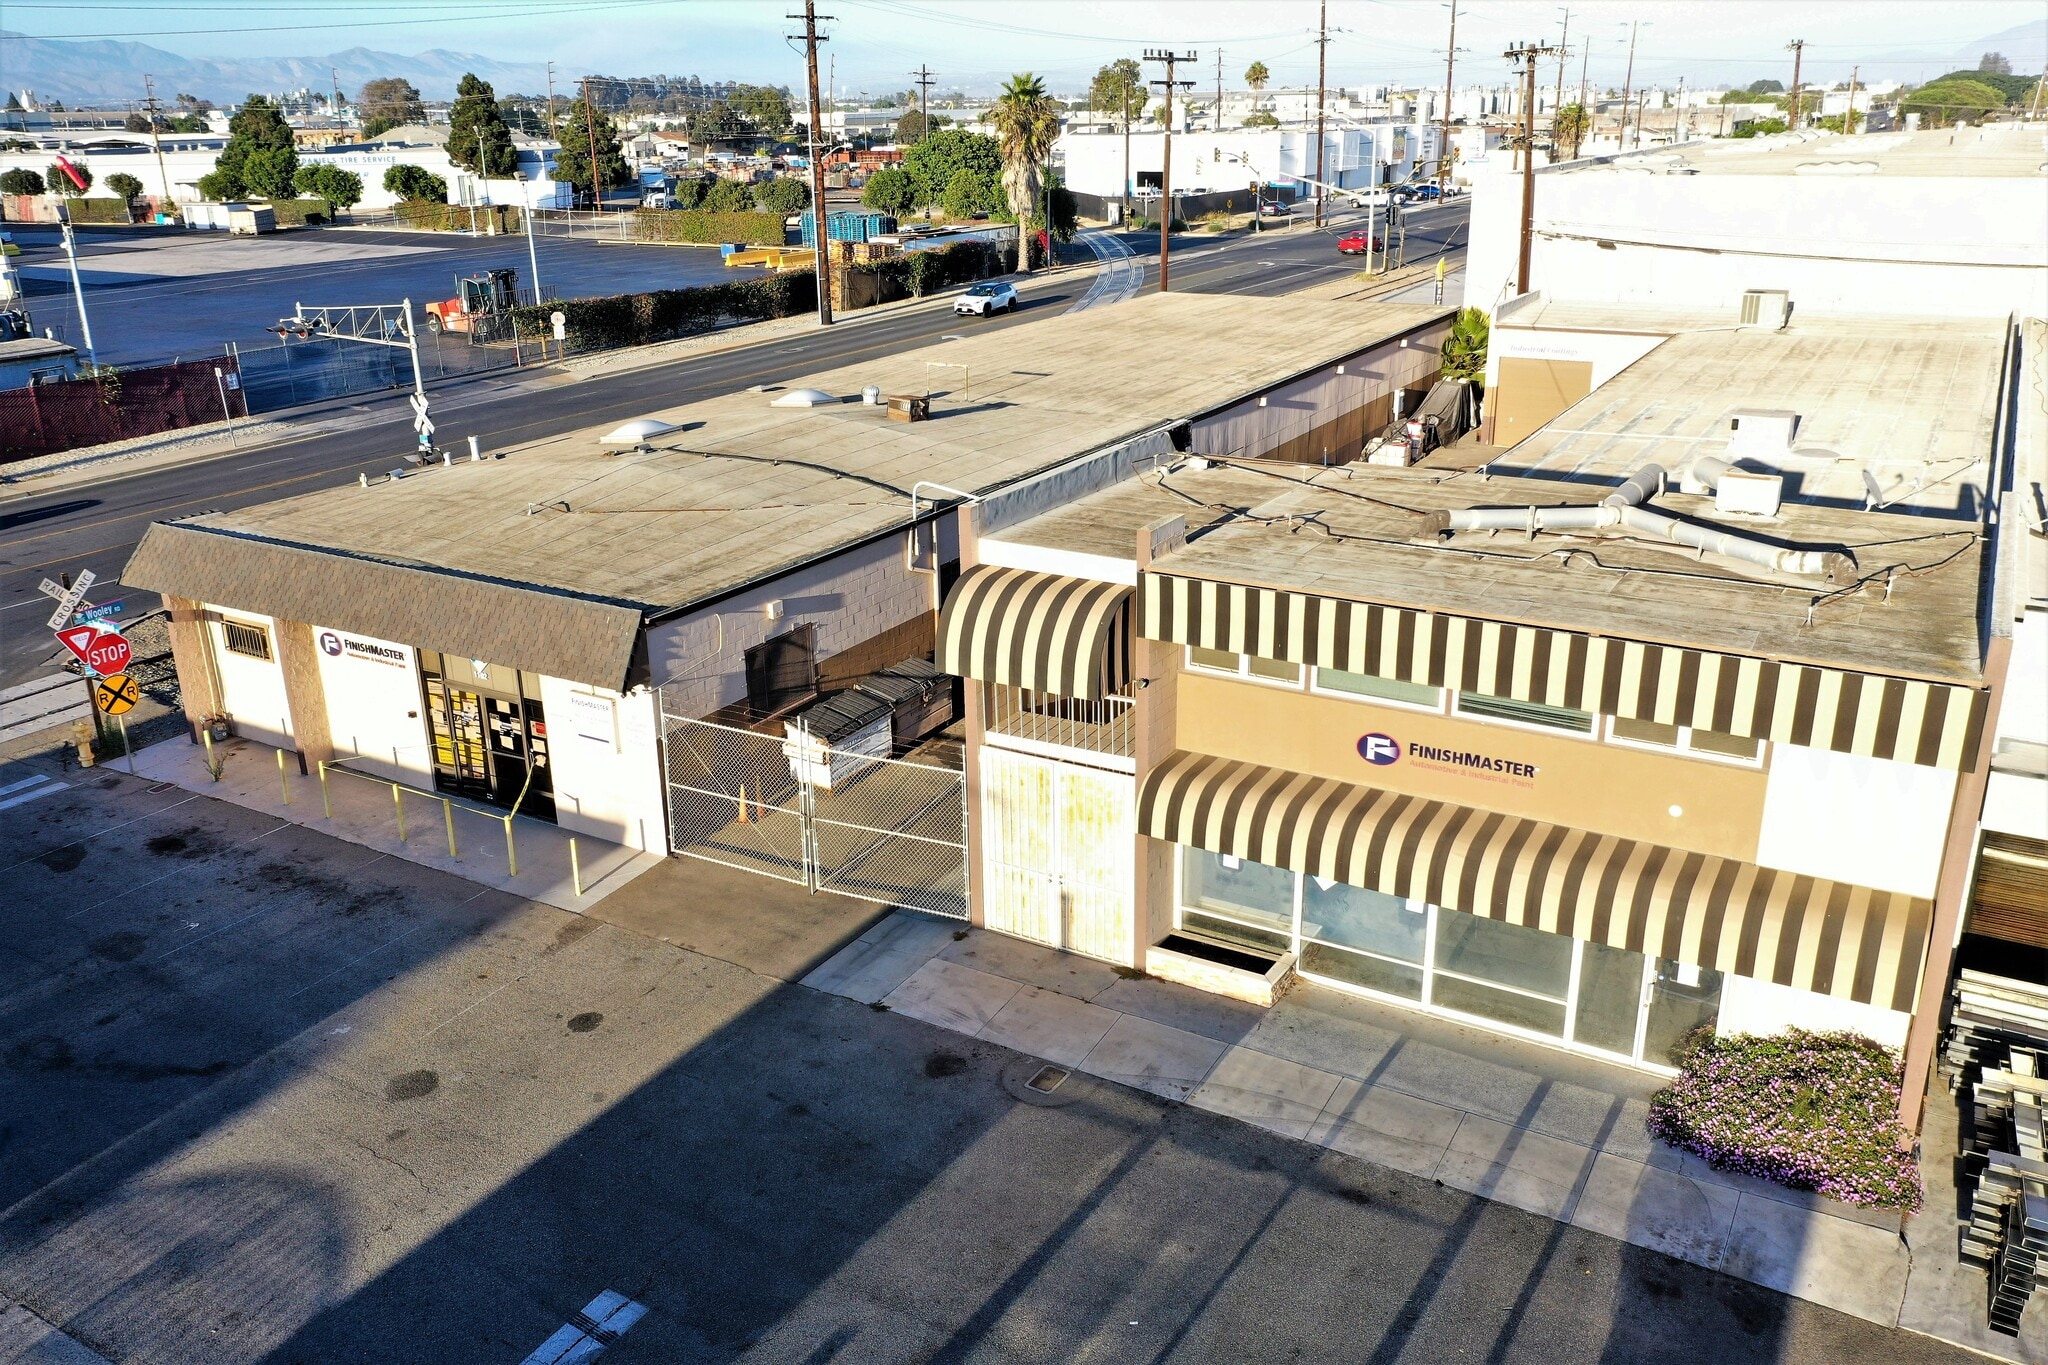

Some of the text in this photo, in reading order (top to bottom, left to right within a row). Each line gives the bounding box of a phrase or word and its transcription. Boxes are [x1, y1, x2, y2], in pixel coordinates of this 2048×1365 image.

[362, 155, 397, 163] SERVICE
[41, 580, 65, 600] RAIL
[53, 573, 92, 627] CROSSING
[85, 602, 113, 620] Wooley
[73, 634, 88, 642] YIELD
[90, 643, 127, 666] STOP
[344, 639, 405, 661] FINISHMASTER
[100, 693, 109, 704] R
[126, 685, 136, 697] R
[1409, 743, 1535, 778] FINISHMASTER
[1409, 759, 1535, 790] Automotive & Industrial Paint
